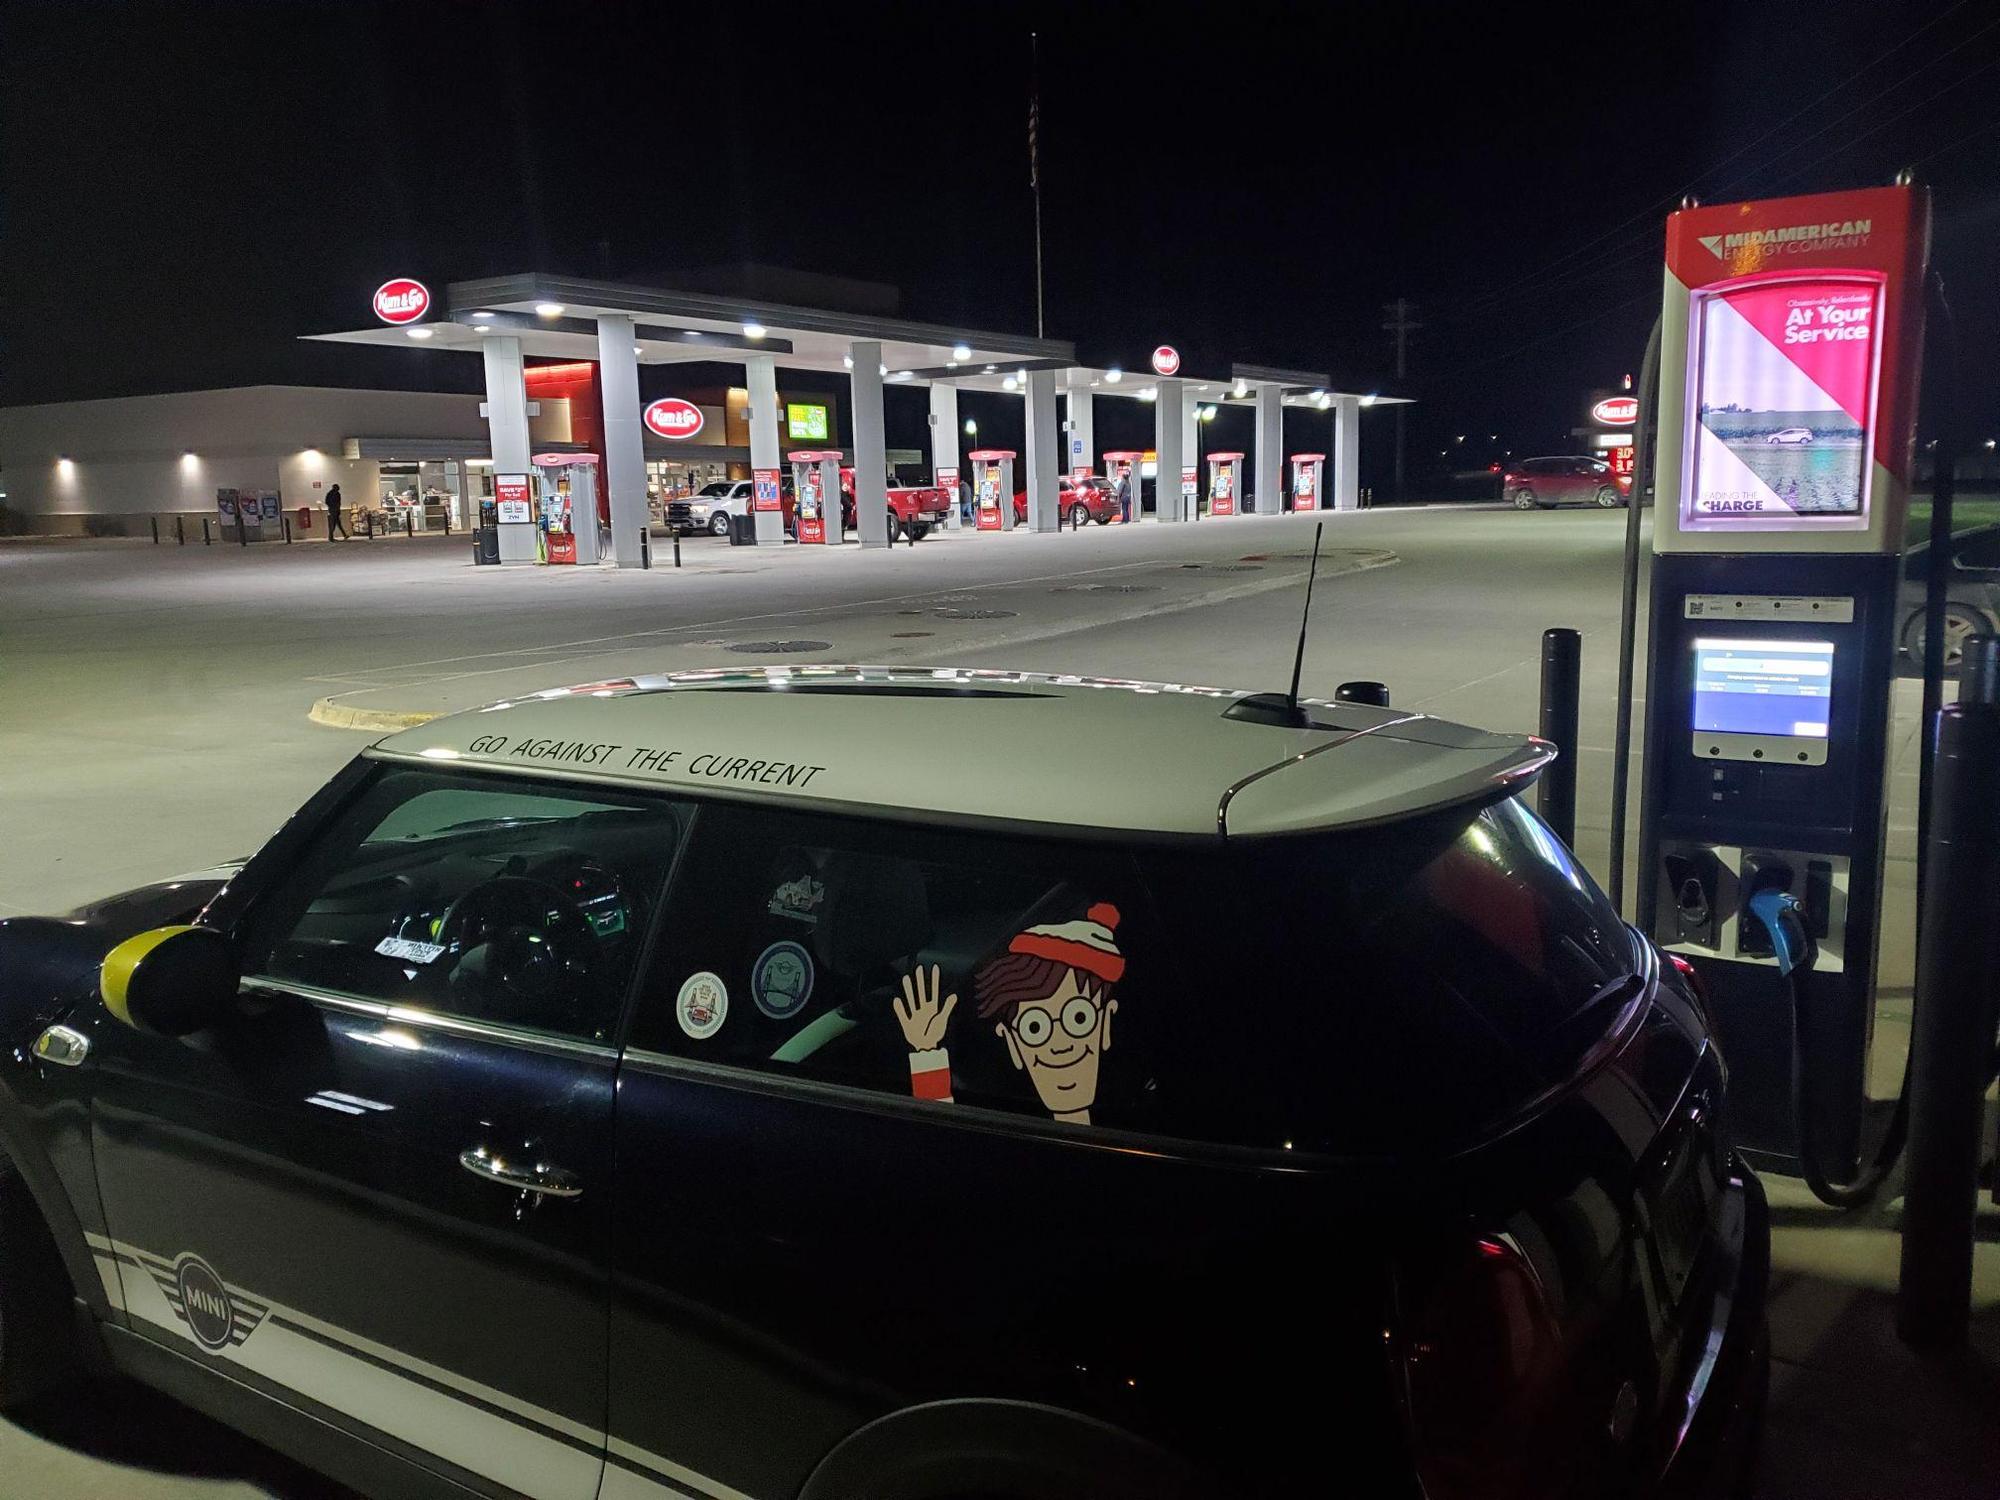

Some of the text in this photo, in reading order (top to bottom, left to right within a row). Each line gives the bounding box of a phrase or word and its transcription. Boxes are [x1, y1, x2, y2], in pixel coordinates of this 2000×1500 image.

[1725, 219, 1872, 248] MIDAMERICAN
[1724, 234, 1870, 260] ENGY COMPANY
[1786, 305, 1871, 326] At Your
[1784, 322, 1870, 344] Service
[1702, 491, 1740, 500] EADING
[469, 735, 827, 788] GO AGAINST THE CURRENT
[185, 1285, 226, 1321] MINI
